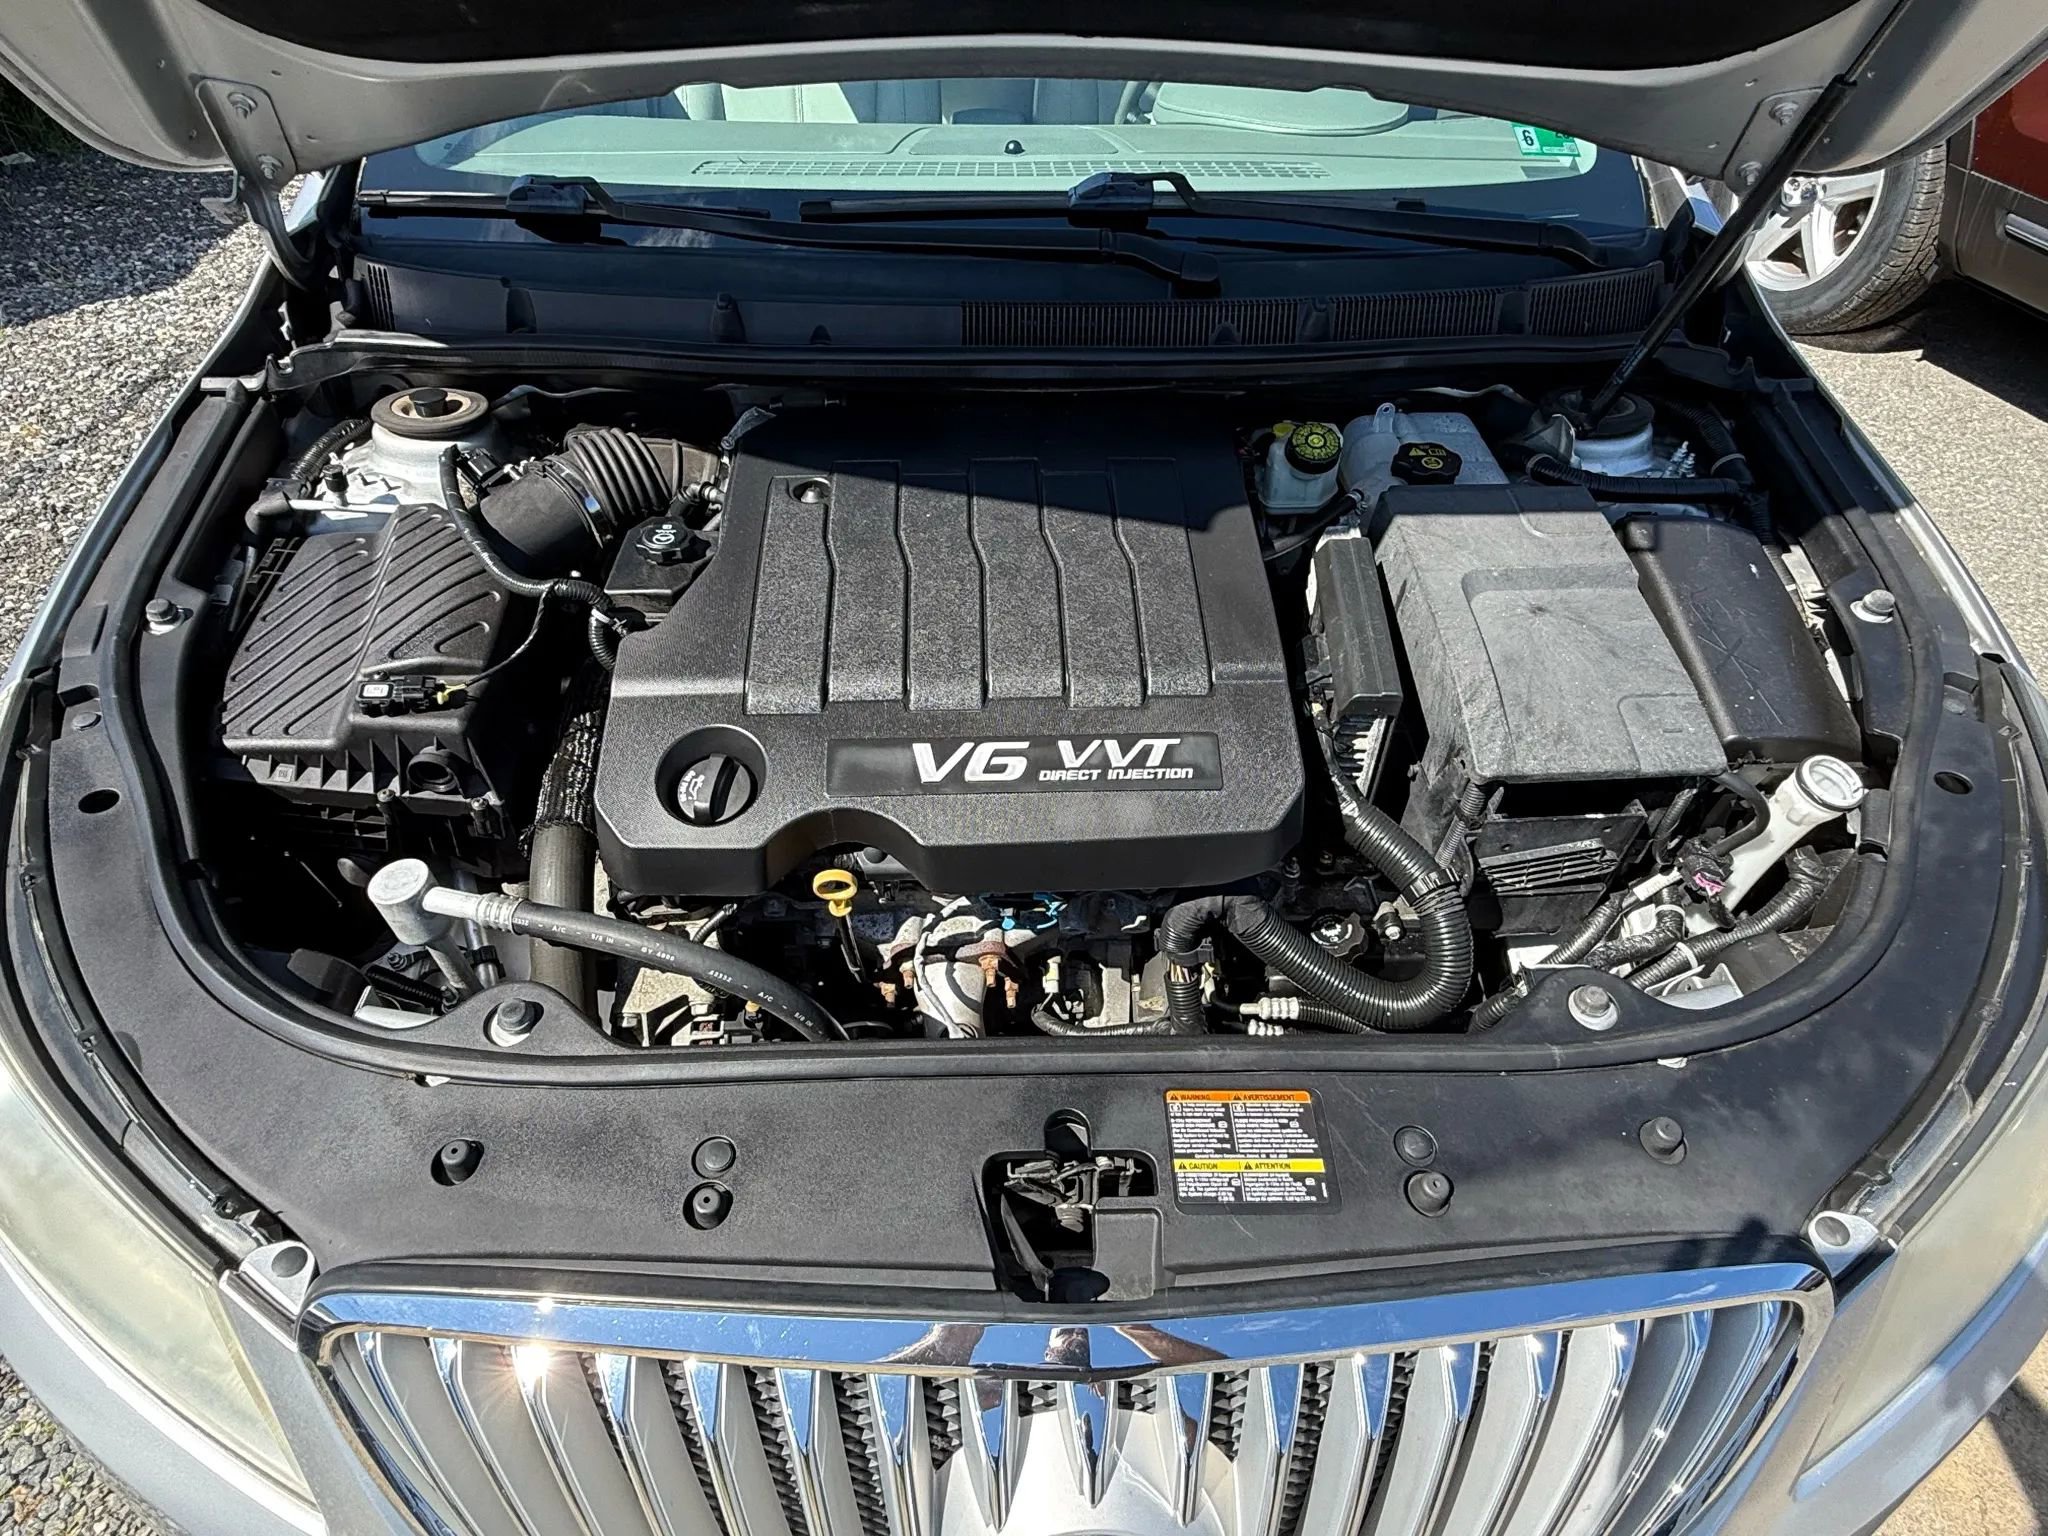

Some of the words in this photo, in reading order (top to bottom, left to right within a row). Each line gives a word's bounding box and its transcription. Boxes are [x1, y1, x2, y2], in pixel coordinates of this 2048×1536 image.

[1522, 129, 1534, 146] 6
[912, 741, 1030, 784] V6
[1057, 738, 1181, 768] VVT
[1039, 768, 1101, 782] DIRECT
[1107, 767, 1193, 780] INJECTION
[1188, 1162, 1218, 1170] CAUTION
[1254, 1162, 1291, 1170] ATTENTION
